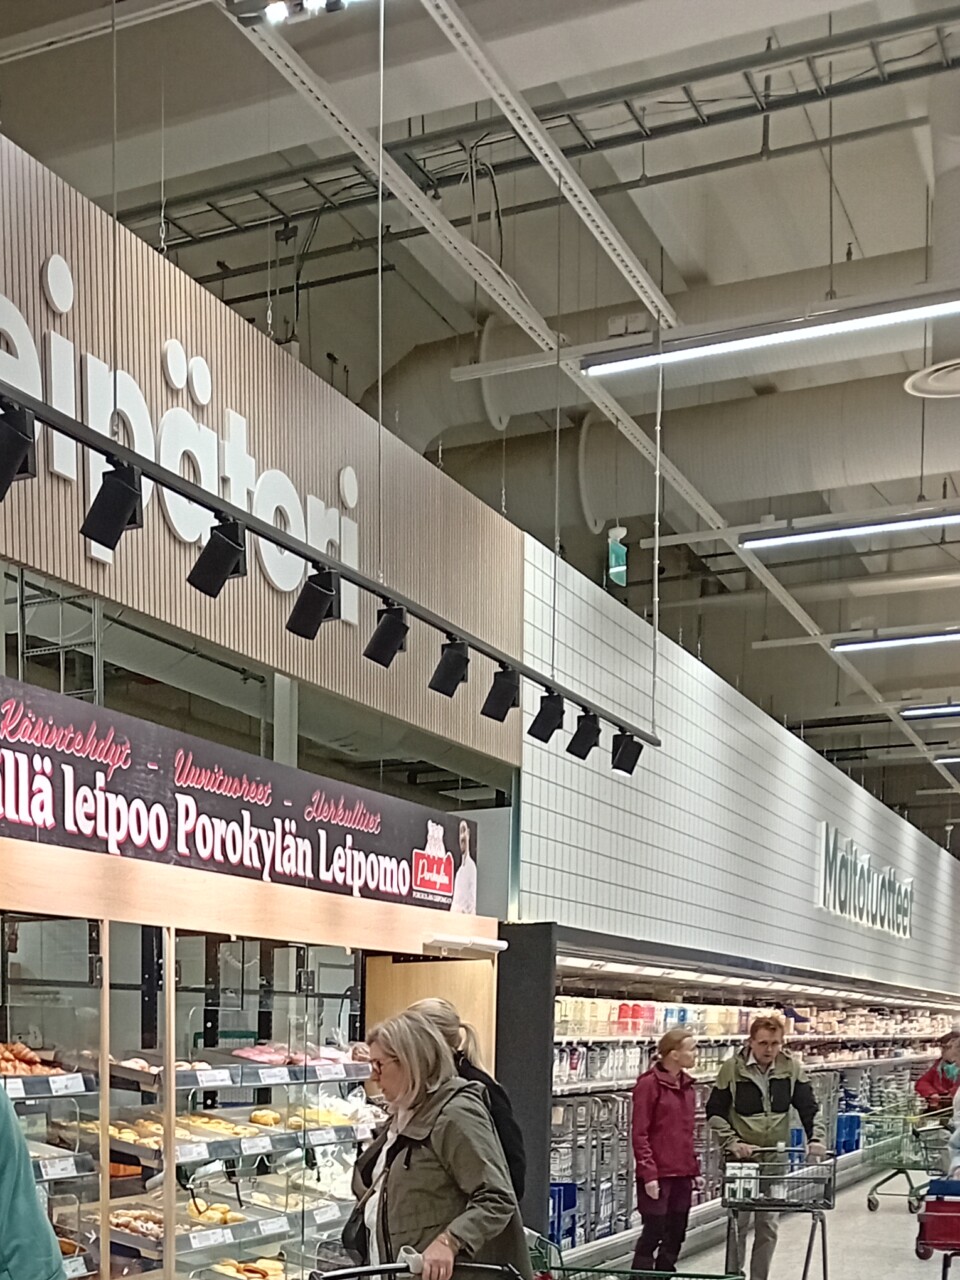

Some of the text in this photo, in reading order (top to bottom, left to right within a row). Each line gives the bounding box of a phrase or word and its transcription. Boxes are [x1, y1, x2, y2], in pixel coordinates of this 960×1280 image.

[0, 697, 132, 782] Käsintehdyt
[174, 747, 273, 808] Uunituoreet
[304, 789, 382, 835] Herkulliset
[60, 762, 170, 857] leipoo
[174, 791, 315, 882] Porokylän
[317, 828, 412, 898] Leipomo
[818, 820, 915, 939] Maitotuotteet
